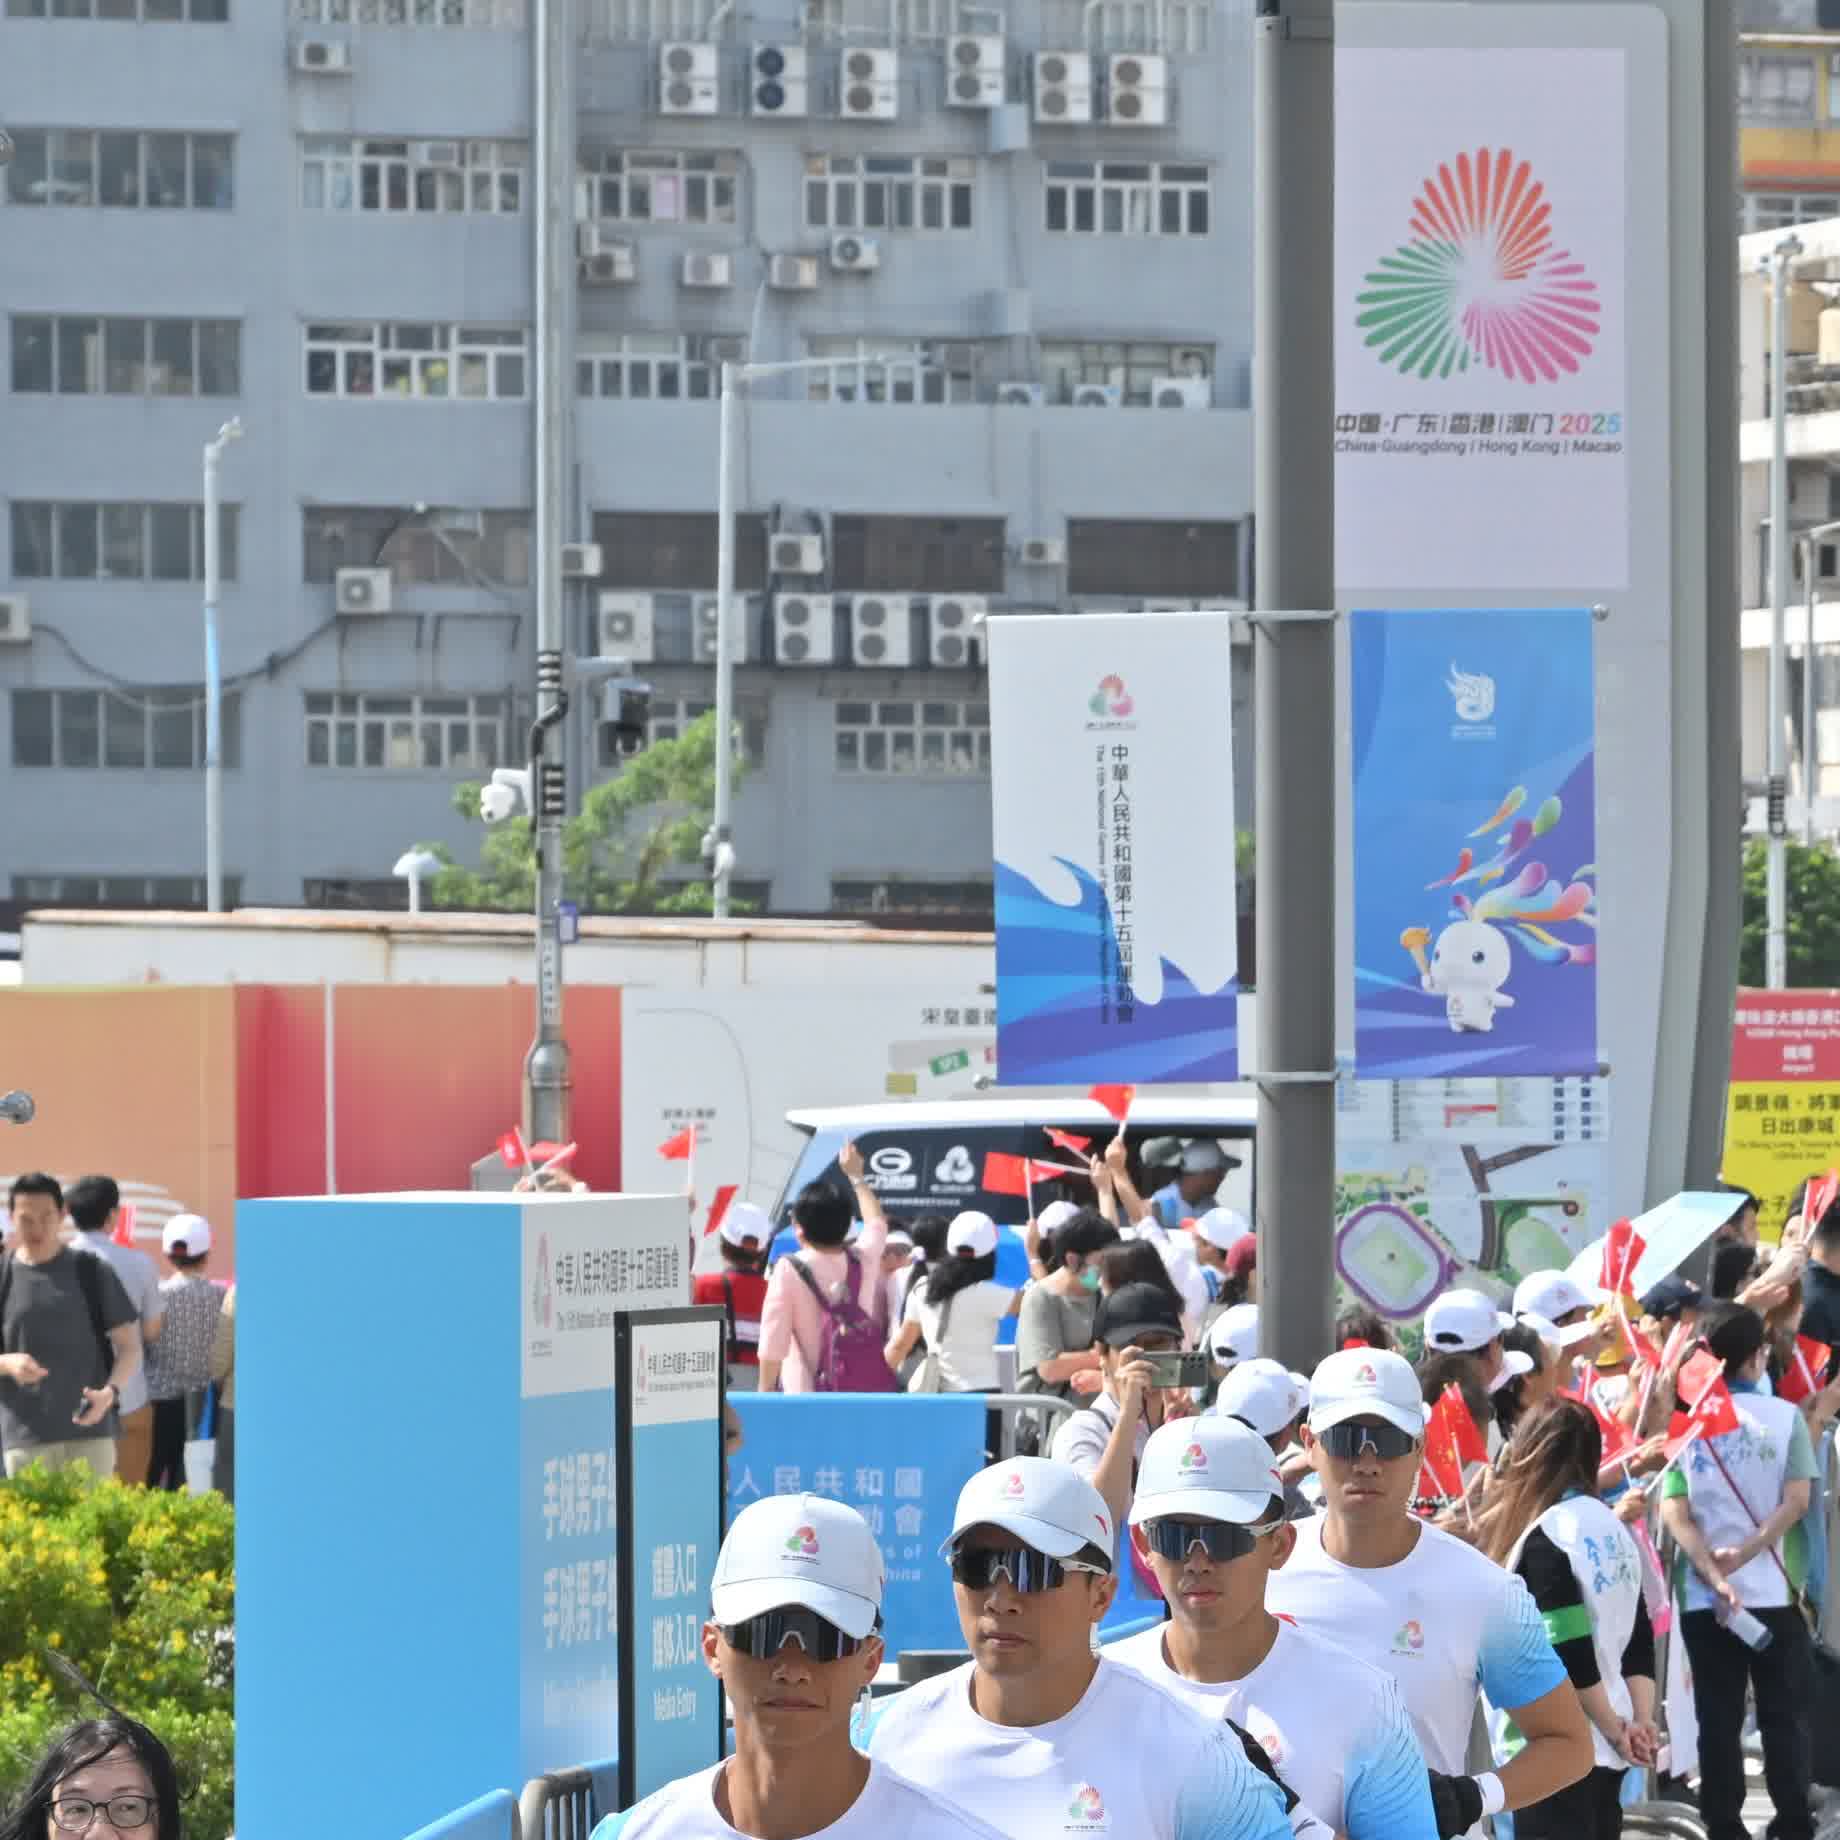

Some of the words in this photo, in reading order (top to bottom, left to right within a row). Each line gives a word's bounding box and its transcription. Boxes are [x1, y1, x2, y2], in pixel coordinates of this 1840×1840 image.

[1560, 413, 1622, 434] 2025
[1479, 440, 1517, 455] Hong
[1522, 440, 1559, 455] Kong
[1573, 440, 1623, 452] Macao
[886, 1567, 921, 1581] hina
